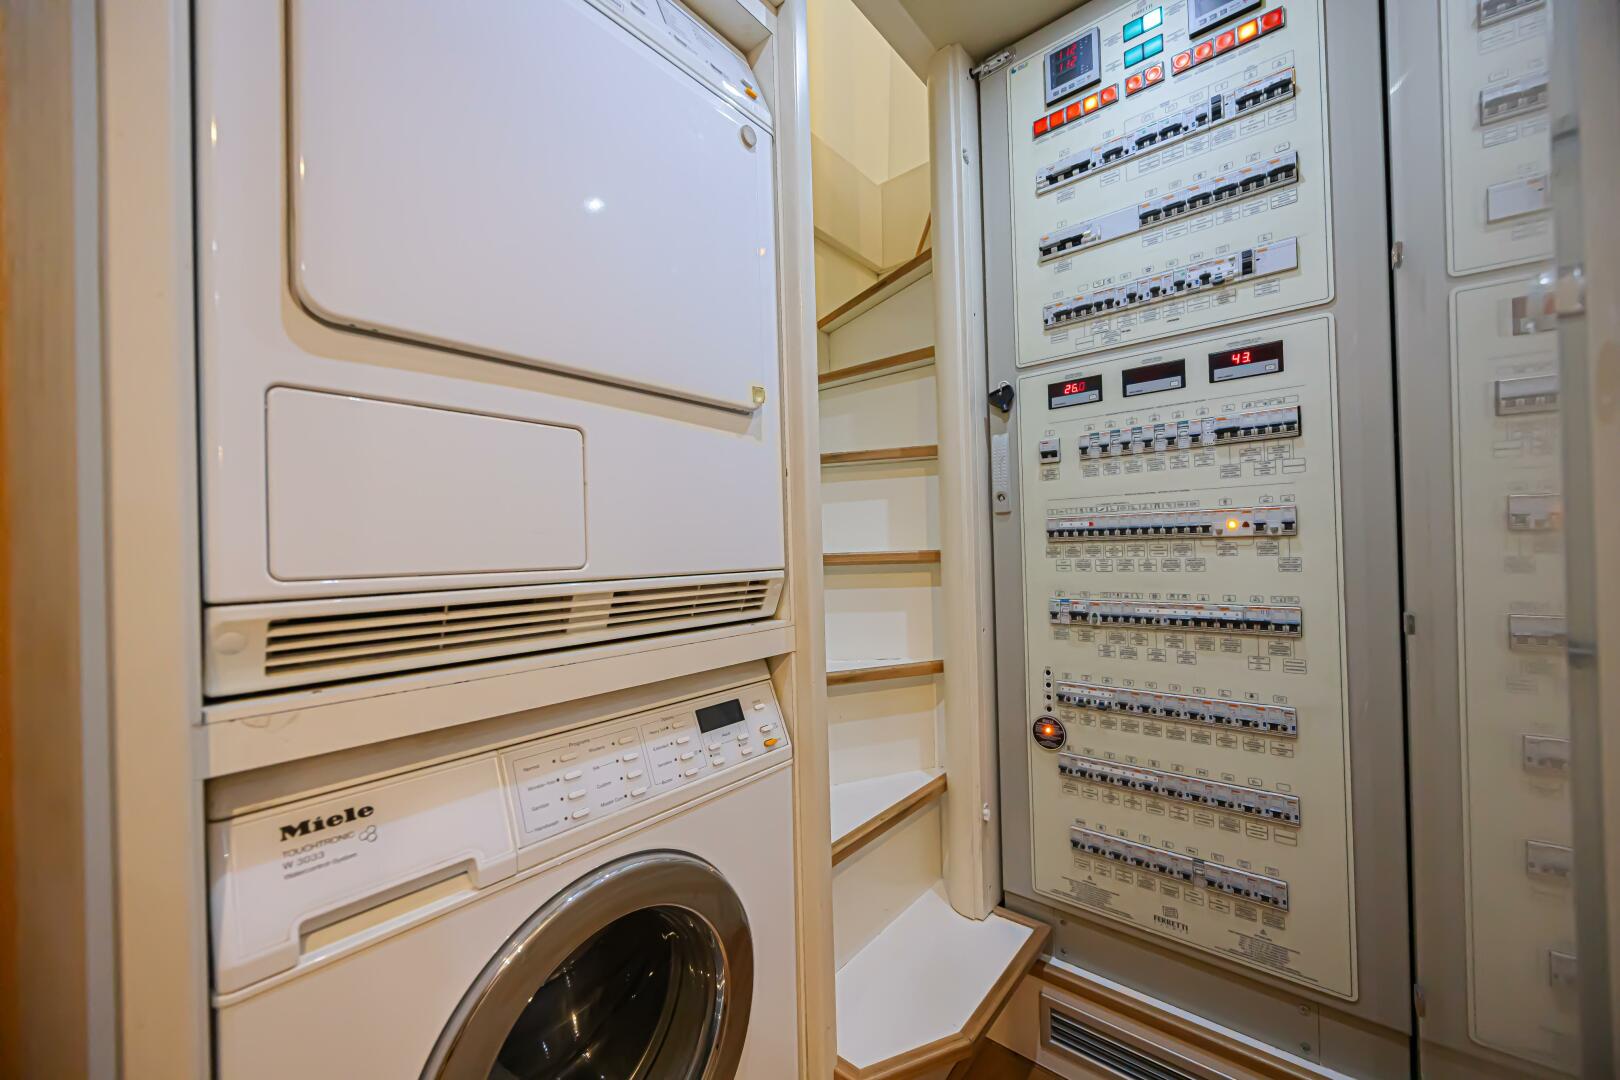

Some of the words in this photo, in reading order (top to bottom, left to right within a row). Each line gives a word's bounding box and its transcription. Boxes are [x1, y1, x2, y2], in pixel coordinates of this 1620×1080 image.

[280, 806, 374, 841] Miele
[282, 831, 354, 857] TOUCHTRONIC
[1153, 914, 1189, 932] FERRETTI
